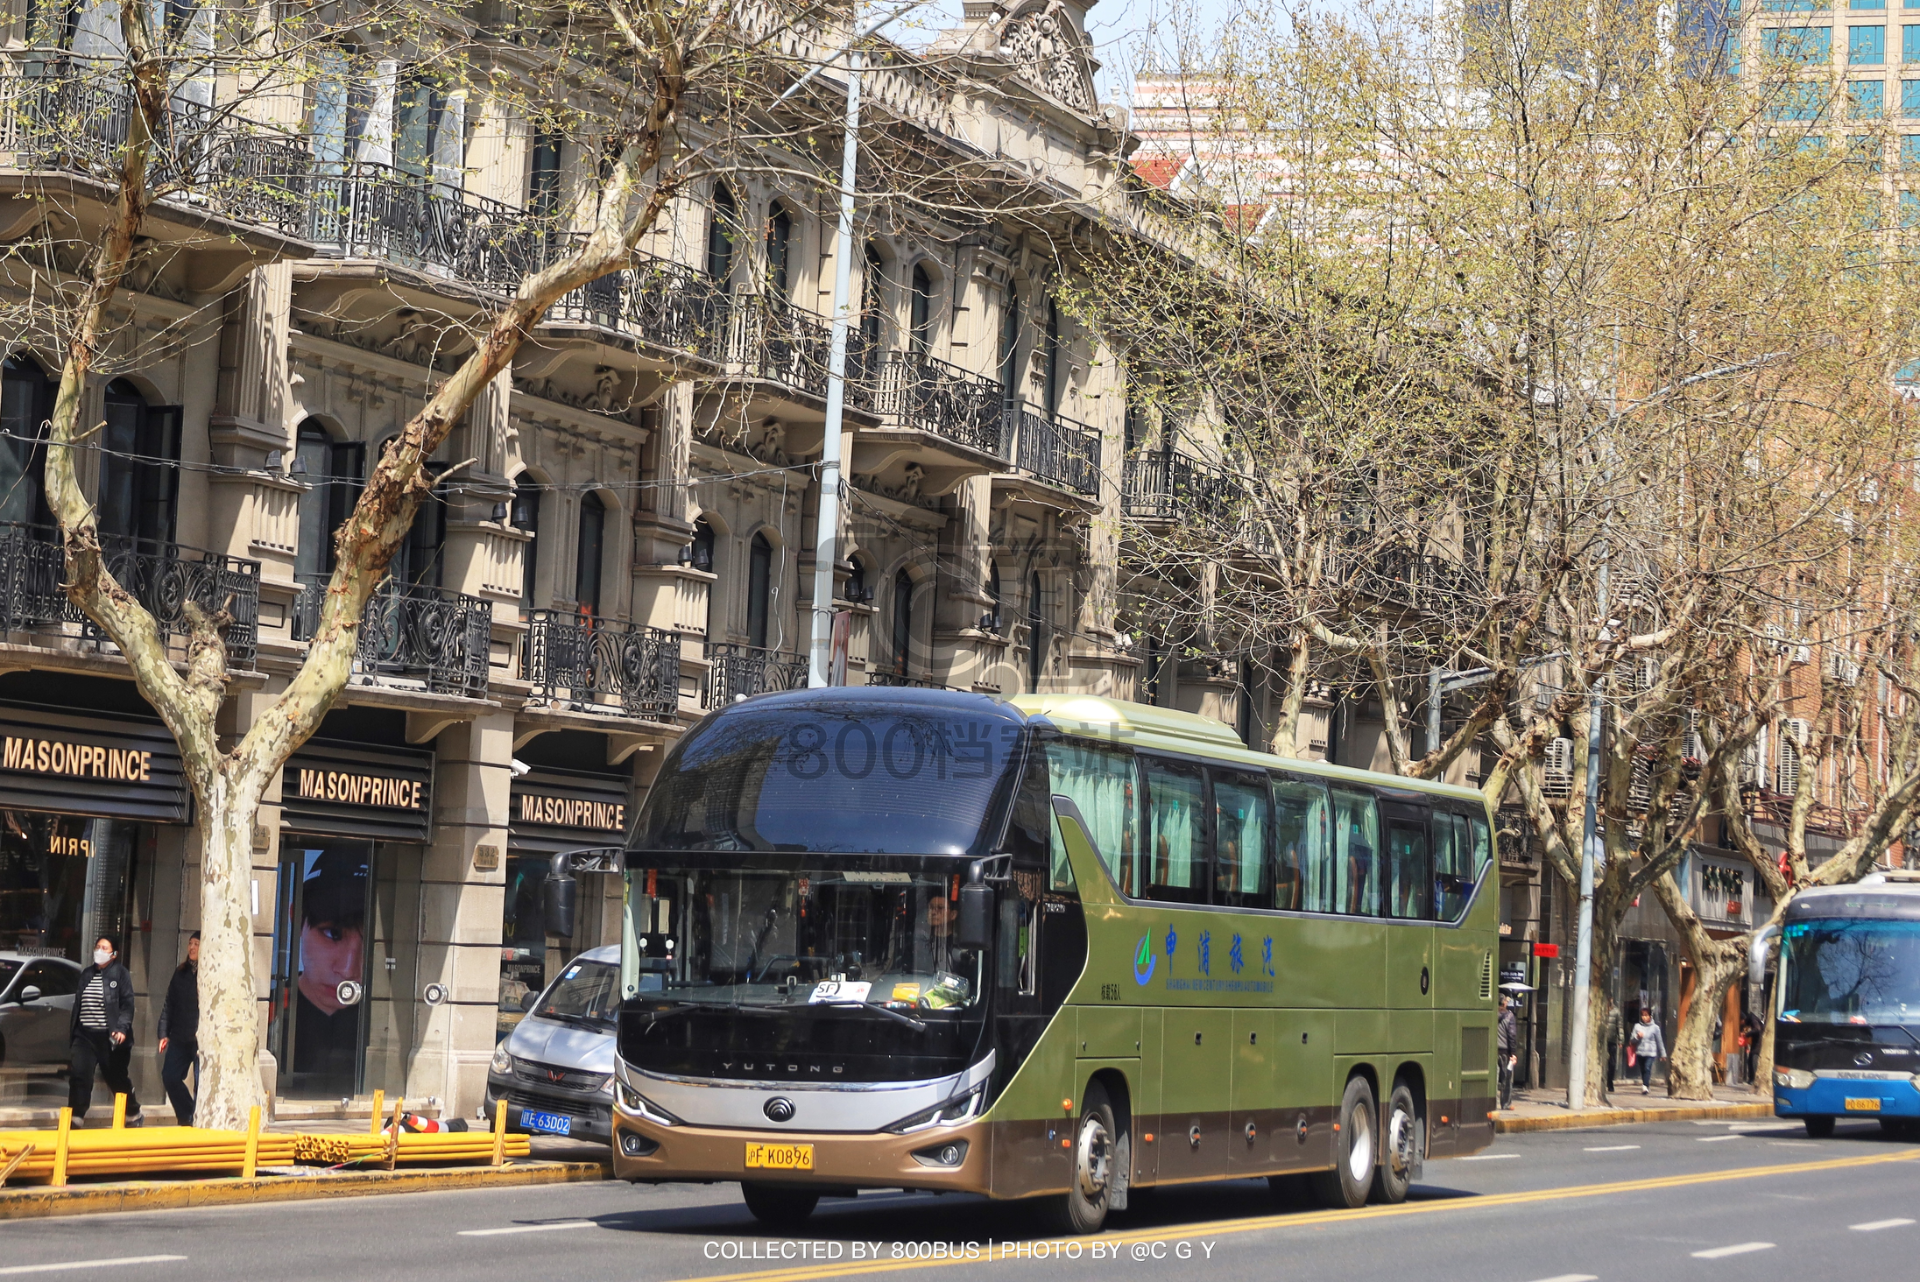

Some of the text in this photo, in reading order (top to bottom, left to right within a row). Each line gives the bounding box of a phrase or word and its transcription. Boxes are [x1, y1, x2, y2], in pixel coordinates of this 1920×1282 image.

[3, 736, 151, 781] MASONPRINCE
[300, 768, 422, 809] MASONPRINCE
[522, 794, 624, 829] MASONPRINCE
[479, 847, 495, 858] 532
[723, 1062, 843, 1073] YUTONG
